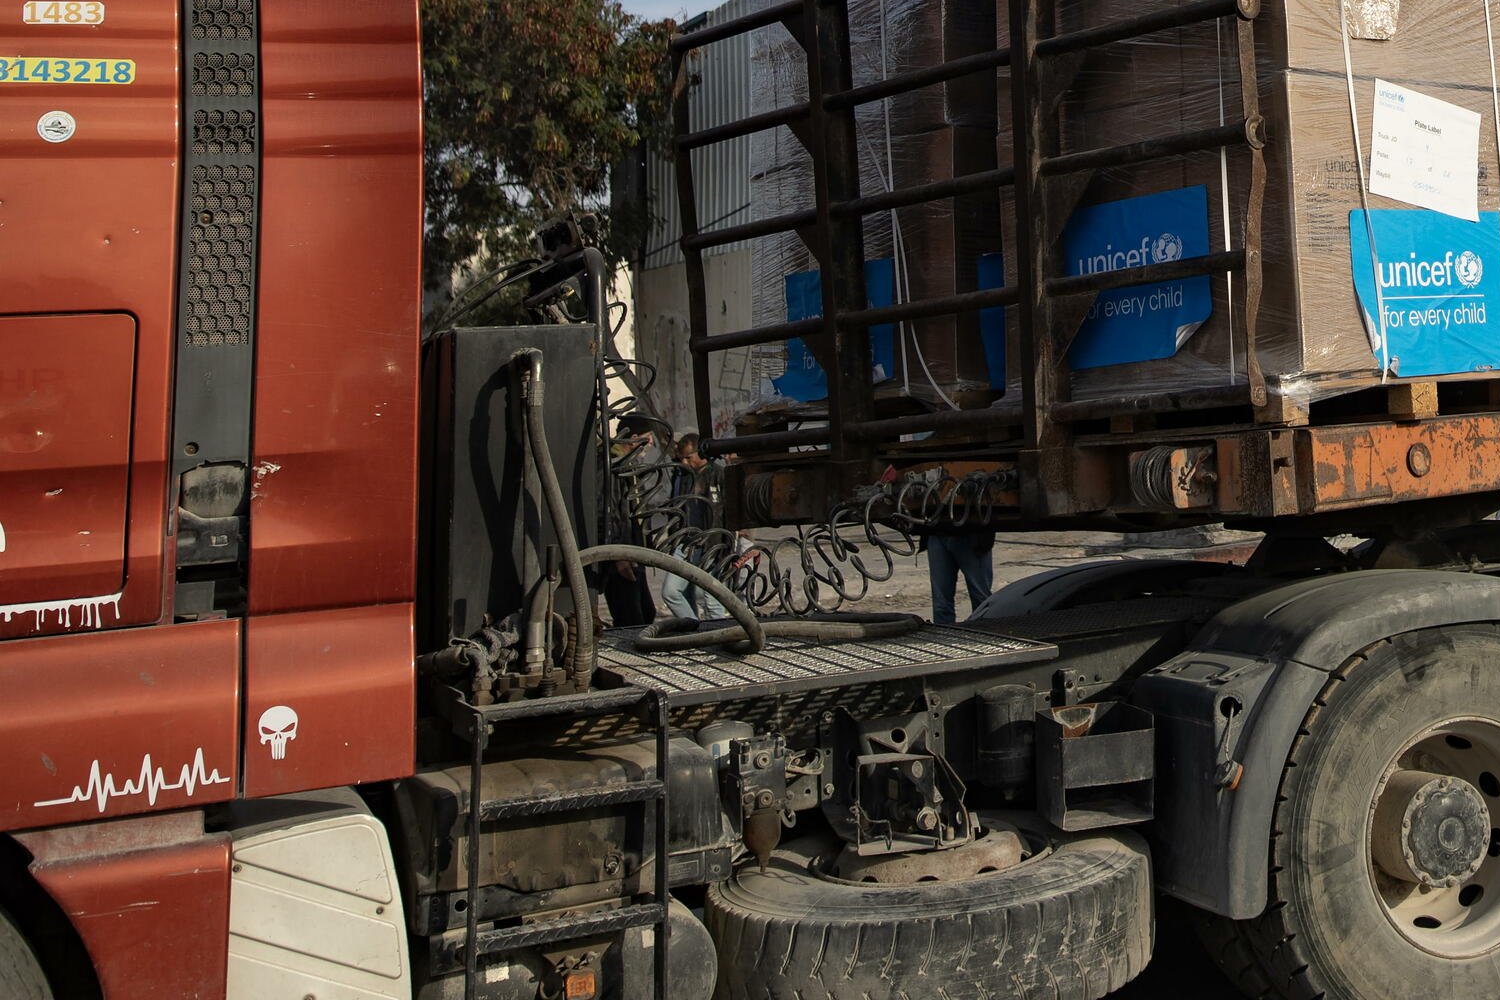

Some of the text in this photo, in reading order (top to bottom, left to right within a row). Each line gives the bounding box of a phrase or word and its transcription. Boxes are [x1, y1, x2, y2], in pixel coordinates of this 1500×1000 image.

[24, 2, 102, 23] 1483
[1427, 123, 1442, 135] Label
[1325, 155, 1360, 173] unice
[1079, 236, 1150, 276] unicef
[1378, 251, 1453, 287] unicef
[1088, 284, 1183, 320] or every child
[1385, 302, 1487, 330] for every child
